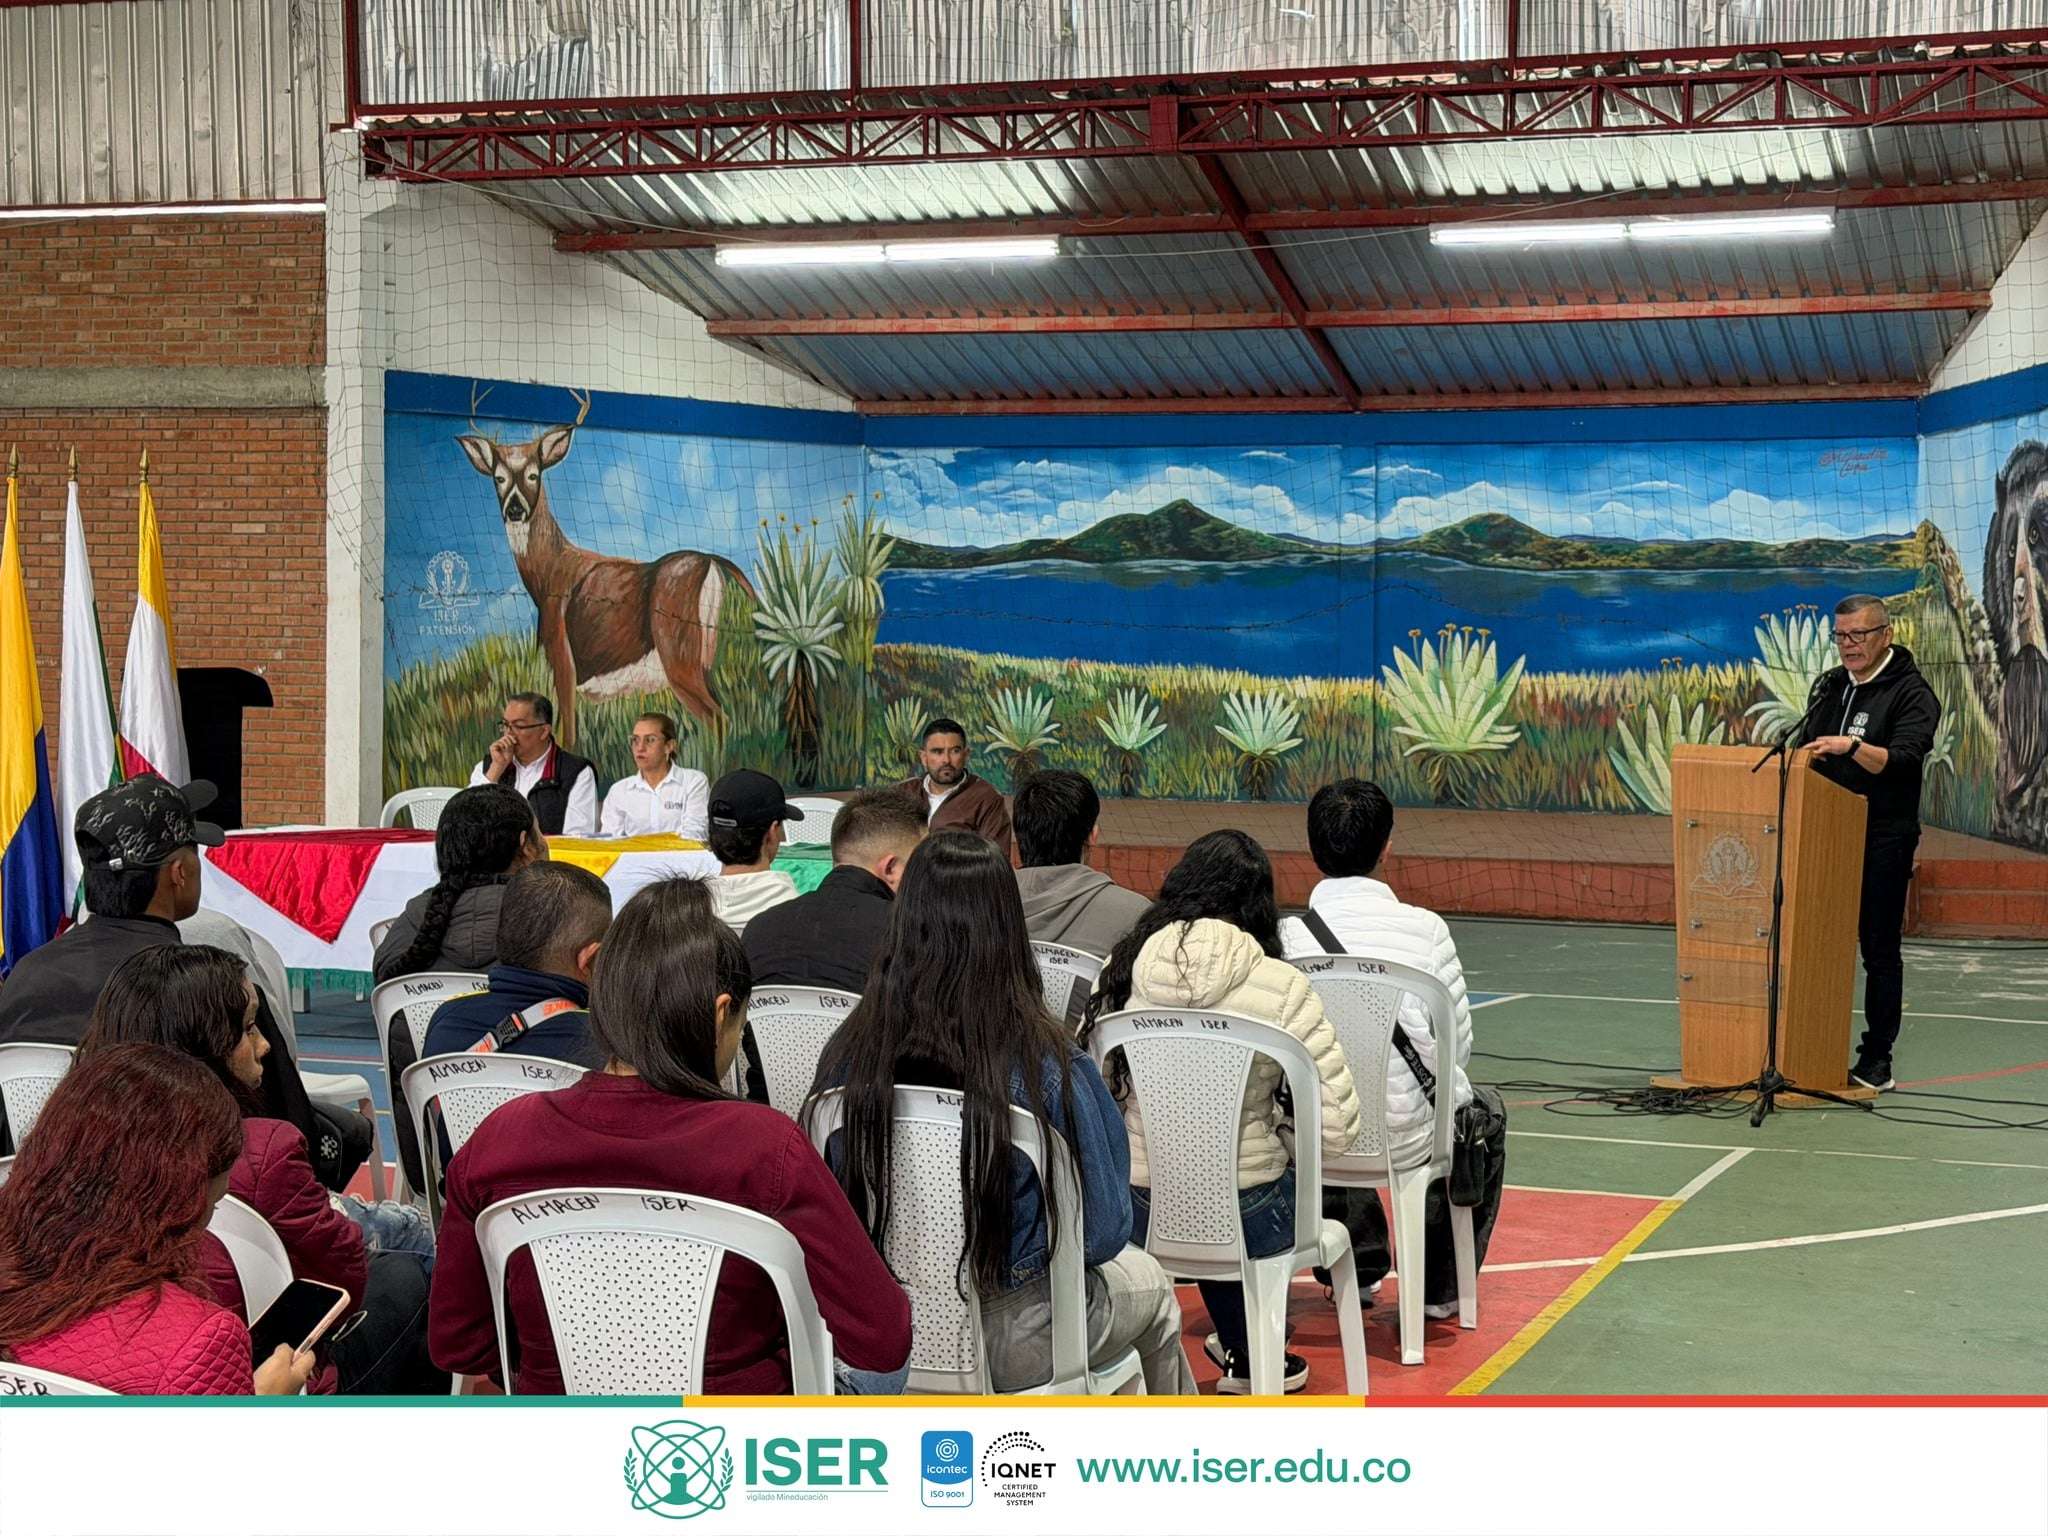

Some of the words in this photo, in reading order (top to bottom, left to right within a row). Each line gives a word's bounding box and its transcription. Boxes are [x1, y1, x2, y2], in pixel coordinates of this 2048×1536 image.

[1049, 957, 1070, 965] ISER
[1357, 962, 1389, 975] ISER
[819, 995, 851, 1008] ISER
[1132, 1017, 1184, 1031] ALMACEN
[1201, 1019, 1230, 1030] ISER
[429, 1058, 487, 1083] ALMACEN
[522, 1064, 555, 1080] ISER
[511, 1193, 601, 1225] ALMACEN
[640, 1196, 697, 1213] ISER
